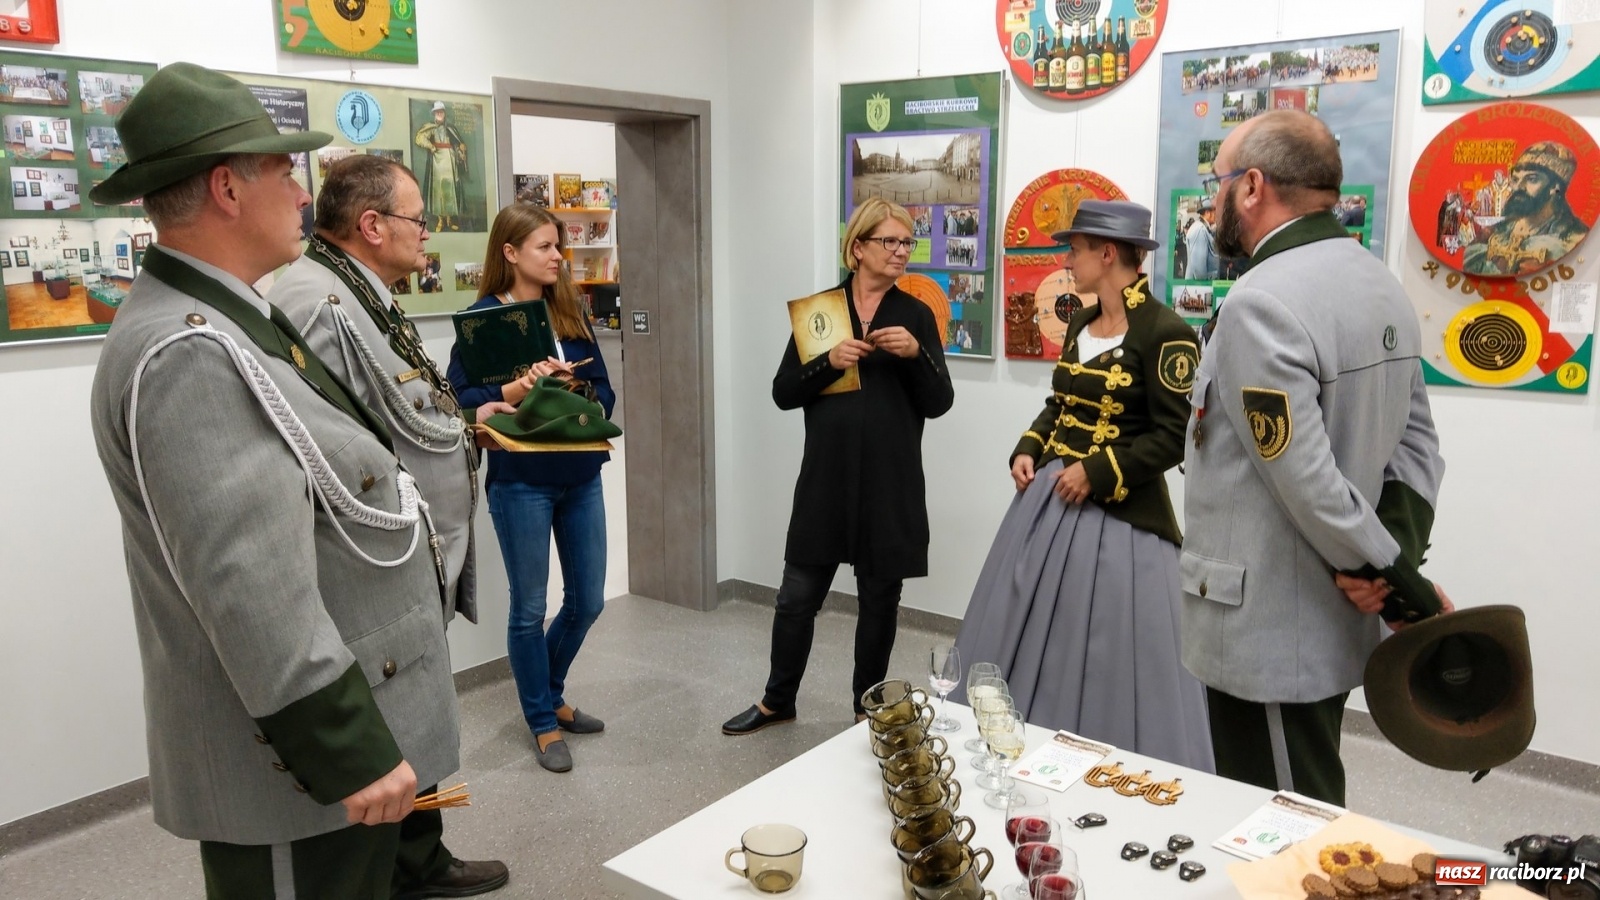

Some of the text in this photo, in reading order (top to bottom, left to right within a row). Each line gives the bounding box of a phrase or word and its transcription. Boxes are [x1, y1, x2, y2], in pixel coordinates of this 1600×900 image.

[1016, 227, 1030, 244] 9
[1007, 254, 1058, 268] TARCZA
[1514, 263, 1575, 297] 2016
[634, 314, 646, 322] WC
